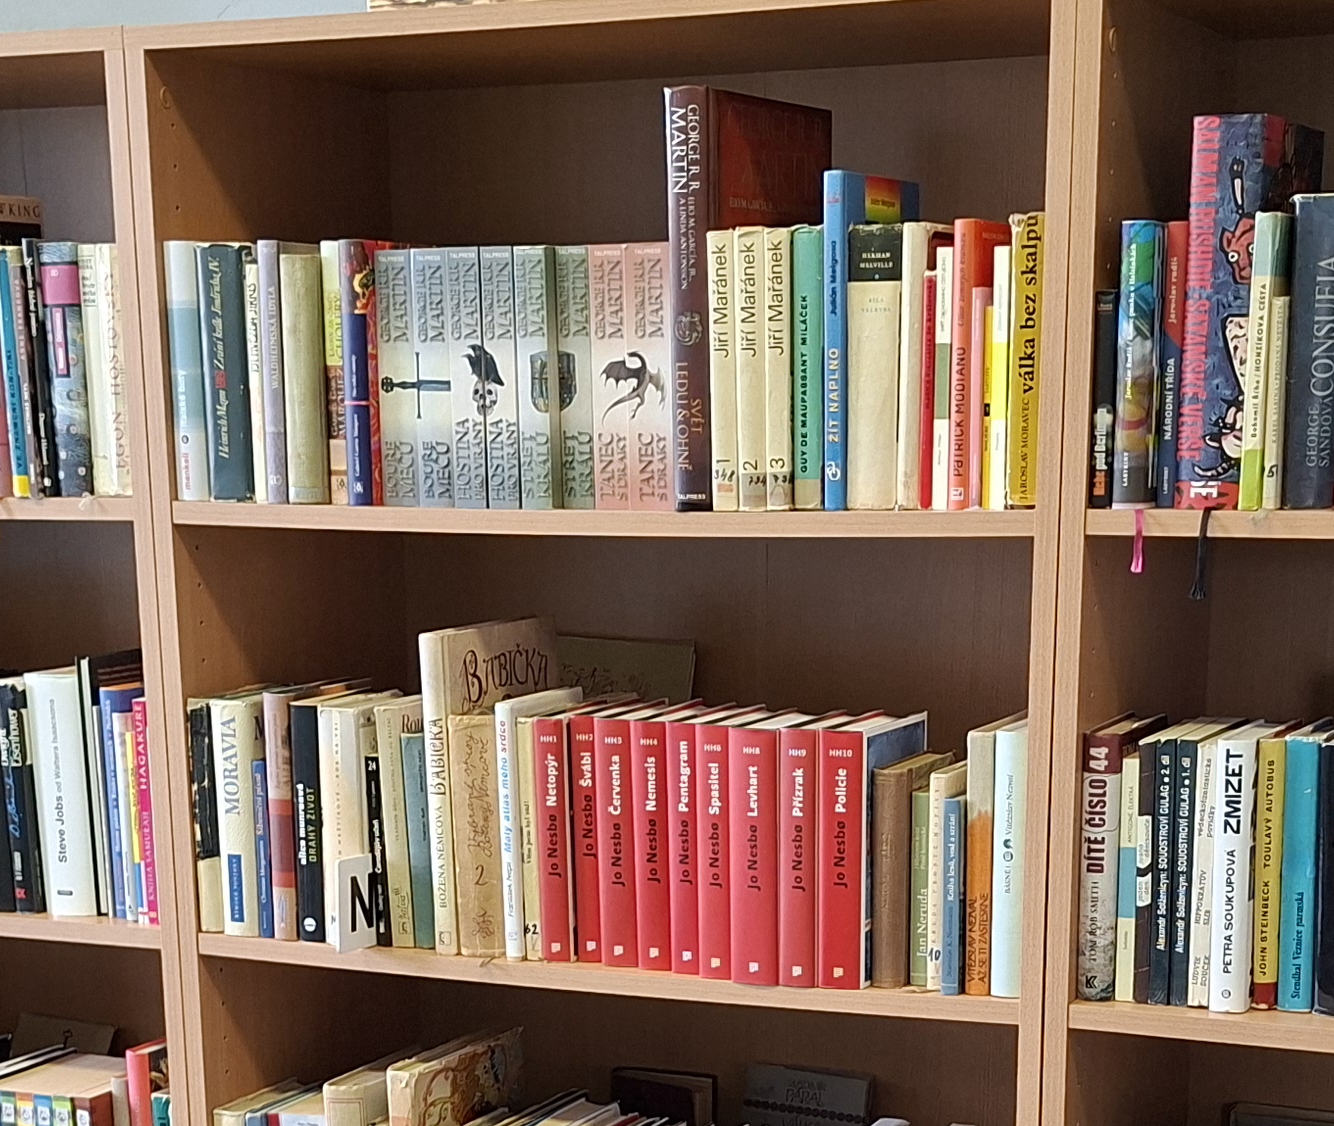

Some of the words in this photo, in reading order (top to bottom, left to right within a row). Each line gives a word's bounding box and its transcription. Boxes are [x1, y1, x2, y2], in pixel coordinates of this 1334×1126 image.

[671, 106, 688, 193] MARTIN
[686, 104, 702, 161] GEORGE
[1024, 214, 1042, 287] skalpu
[712, 243, 726, 323] Mařánek
[800, 295, 808, 347] MILÁČEK
[1025, 296, 1036, 331] bez
[713, 326, 729, 358] Jiří
[1022, 340, 1036, 394] válka
[799, 352, 807, 425] MAUPASSANT
[828, 348, 838, 410] NAPLNO
[1166, 358, 1175, 389] TŘÍDA
[799, 431, 807, 446] DE
[828, 414, 838, 442] ŽÍT
[1164, 391, 1173, 440] NÁRODNÍ
[799, 450, 807, 473] GUY
[134, 705, 148, 790] HAGAKURE
[223, 716, 241, 817] MORAVIA
[1090, 747, 1110, 771] 44
[547, 752, 557, 806] Netopýr
[608, 755, 621, 814] Červenka
[645, 756, 657, 811] Nemesis
[678, 741, 690, 812] Pentagram
[709, 763, 721, 815] Spasitel
[747, 765, 758, 817] Levhart
[792, 767, 804, 817] Přízrak
[835, 768, 846, 812] Policie
[1087, 777, 1107, 829] ČÍSLO
[1224, 750, 1244, 836] ZMIZET
[1266, 759, 1275, 813] AUTOBUS
[57, 797, 66, 824] Jobs
[59, 829, 68, 863] Steve
[1086, 836, 1107, 875] DÍTĚ
[1263, 816, 1273, 869] TOULAVÝ
[351, 873, 374, 932] N
[1225, 848, 1237, 929] SOUKUPOVÁ
[1260, 880, 1269, 944] STEINBECK
[1223, 935, 1235, 974] PETRA
